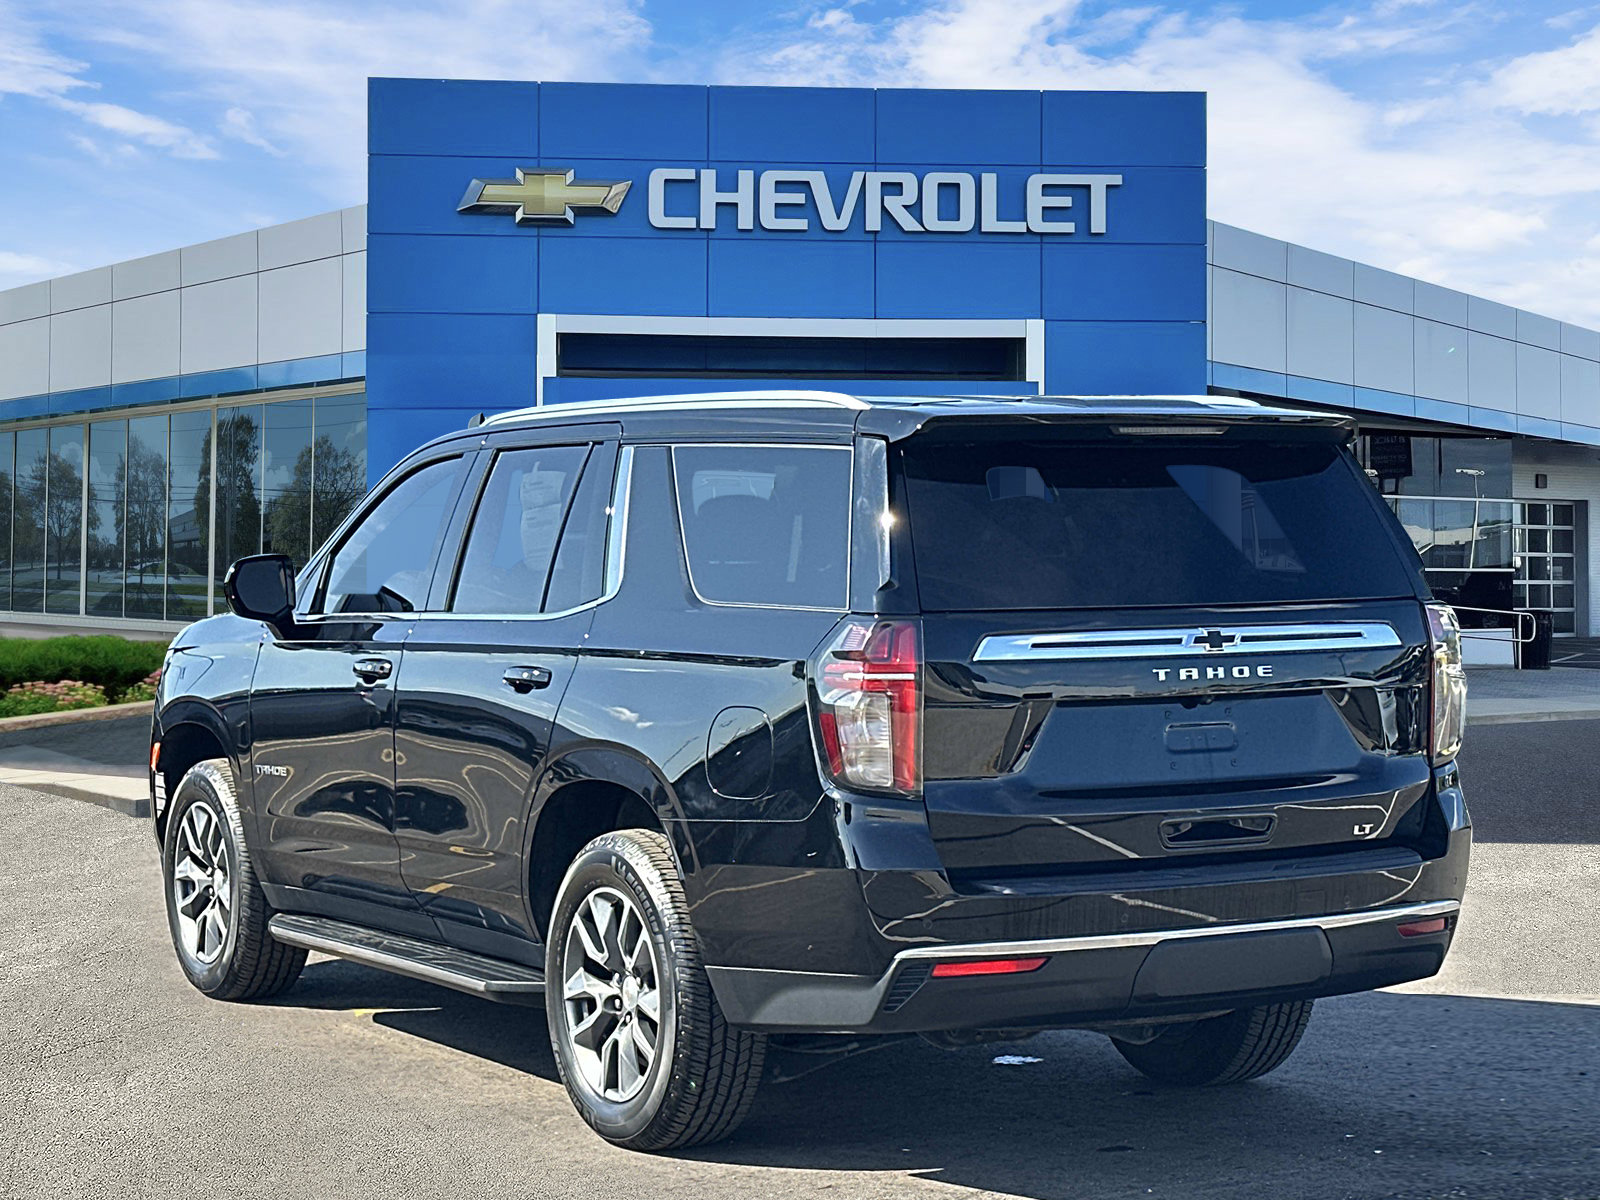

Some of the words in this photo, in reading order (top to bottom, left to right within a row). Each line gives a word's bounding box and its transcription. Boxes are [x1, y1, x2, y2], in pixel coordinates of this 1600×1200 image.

[648, 168, 1123, 234] CHEVROLET
[1152, 665, 1274, 682] TAHOE
[255, 764, 288, 777] TAHOE
[1353, 823, 1375, 836] LT
